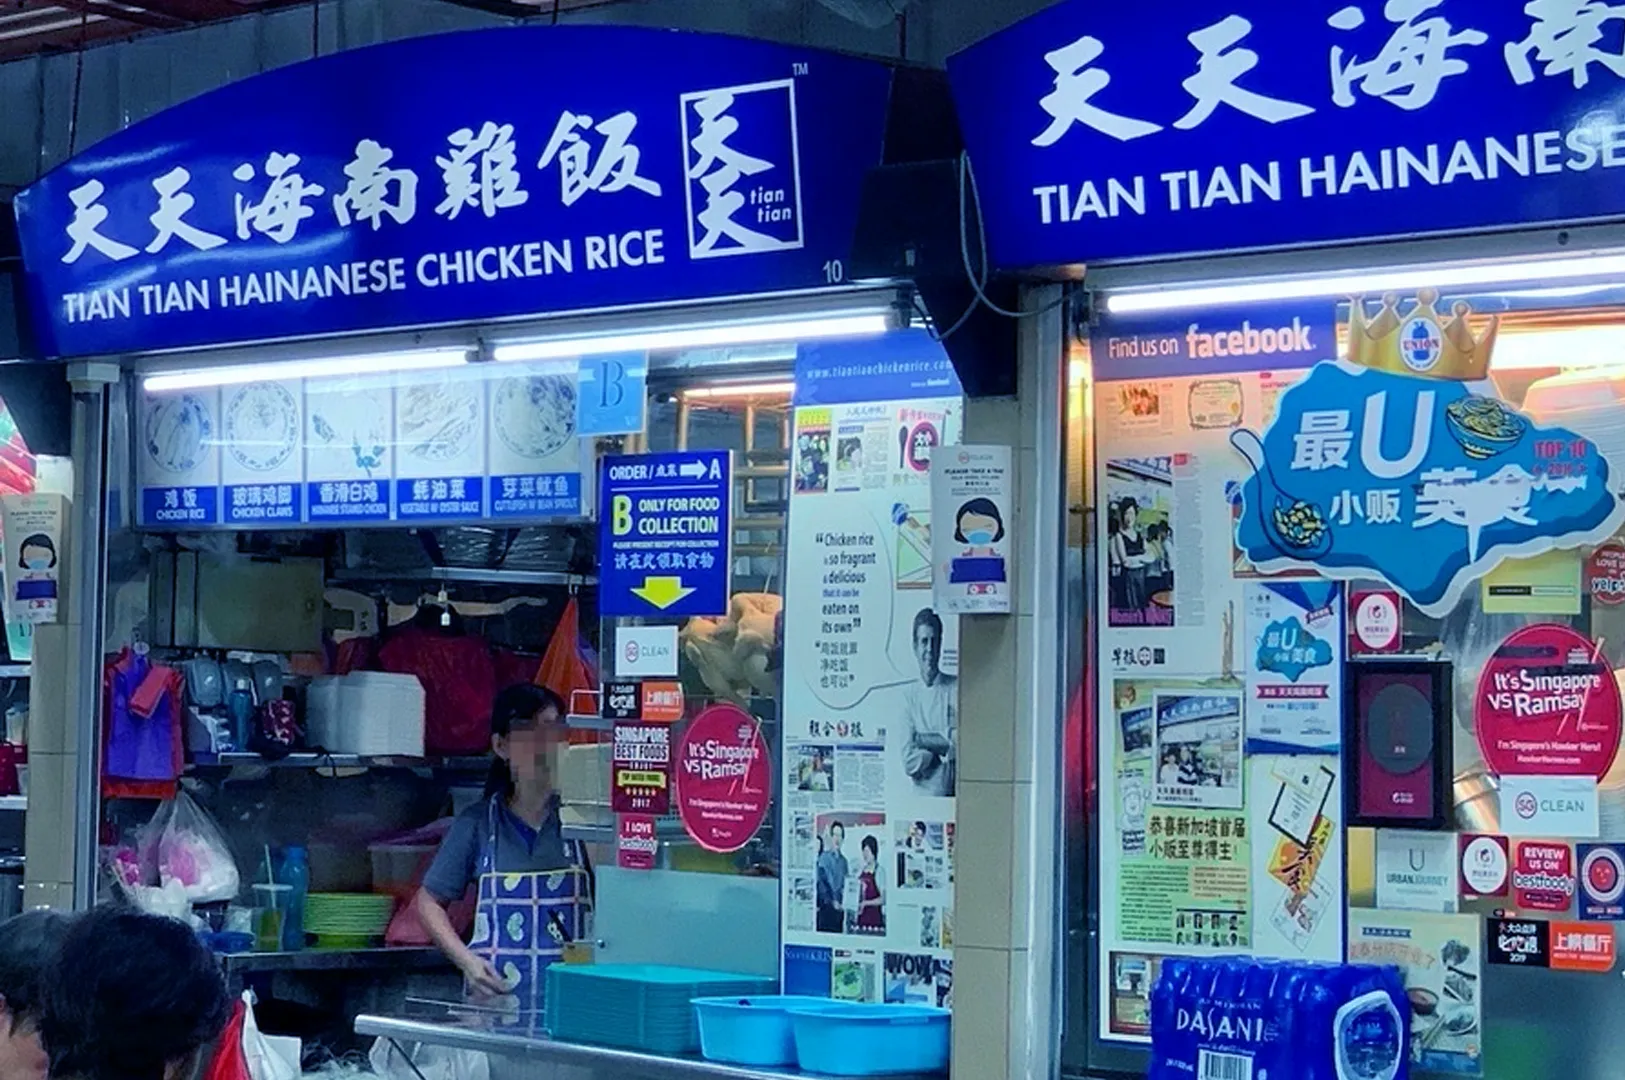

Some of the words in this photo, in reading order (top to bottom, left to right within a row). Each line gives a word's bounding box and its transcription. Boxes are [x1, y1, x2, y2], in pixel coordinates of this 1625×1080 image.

[1033, 176, 1146, 225] TIAN
[1161, 161, 1282, 212] TIAN
[1300, 123, 1625, 199] HAINANESE
[61, 110, 662, 264] 天天海南雞飯
[750, 188, 785, 205] tian
[757, 205, 793, 223] tian
[63, 288, 131, 323] TIAN
[138, 279, 211, 316] TIAN
[219, 258, 406, 308] HAINANESE
[416, 239, 573, 287] CHICKEN
[585, 228, 665, 272] RICE
[821, 259, 843, 284] 10
[1108, 337, 1139, 360] Find
[1141, 339, 1158, 357] us
[1159, 337, 1179, 356] on
[1403, 339, 1440, 351] UNION
[600, 360, 624, 408] B
[1534, 440, 1564, 459] TOP
[609, 465, 648, 481] ORDER
[709, 458, 722, 480] A
[165, 488, 198, 509] 鸡饭
[413, 479, 466, 501] 蚝油菜
[156, 508, 188, 520] CHICKEN
[189, 508, 206, 519] RICE
[232, 507, 266, 519] CHICKEN
[638, 498, 665, 513] ONLY
[666, 497, 688, 512] FOR
[689, 497, 720, 511] FOOD
[612, 494, 633, 536] B
[638, 516, 719, 535] COLLECTION
[858, 532, 874, 546] rice
[614, 551, 715, 570] 请在此领取食物
[840, 550, 876, 569] fragrant
[828, 569, 867, 584] delicious
[822, 603, 846, 615] eaten
[848, 604, 860, 615] on
[822, 620, 833, 633] its
[1495, 673, 1519, 691] It's
[1520, 669, 1601, 696] Singapore
[1513, 691, 1587, 717] Ramsay
[615, 726, 669, 744] SINGAPORE
[616, 744, 638, 759] BEST
[639, 745, 667, 760] FOODS
[689, 742, 706, 758] It's
[1540, 799, 1585, 813] CLEAN
[631, 822, 652, 834] LOVE
[1524, 846, 1566, 860] REVIEW
[1529, 860, 1542, 870] US
[1543, 860, 1560, 871] ON
[1553, 931, 1613, 954] 上榜餐厅
[1176, 1007, 1264, 1042] DASANI
